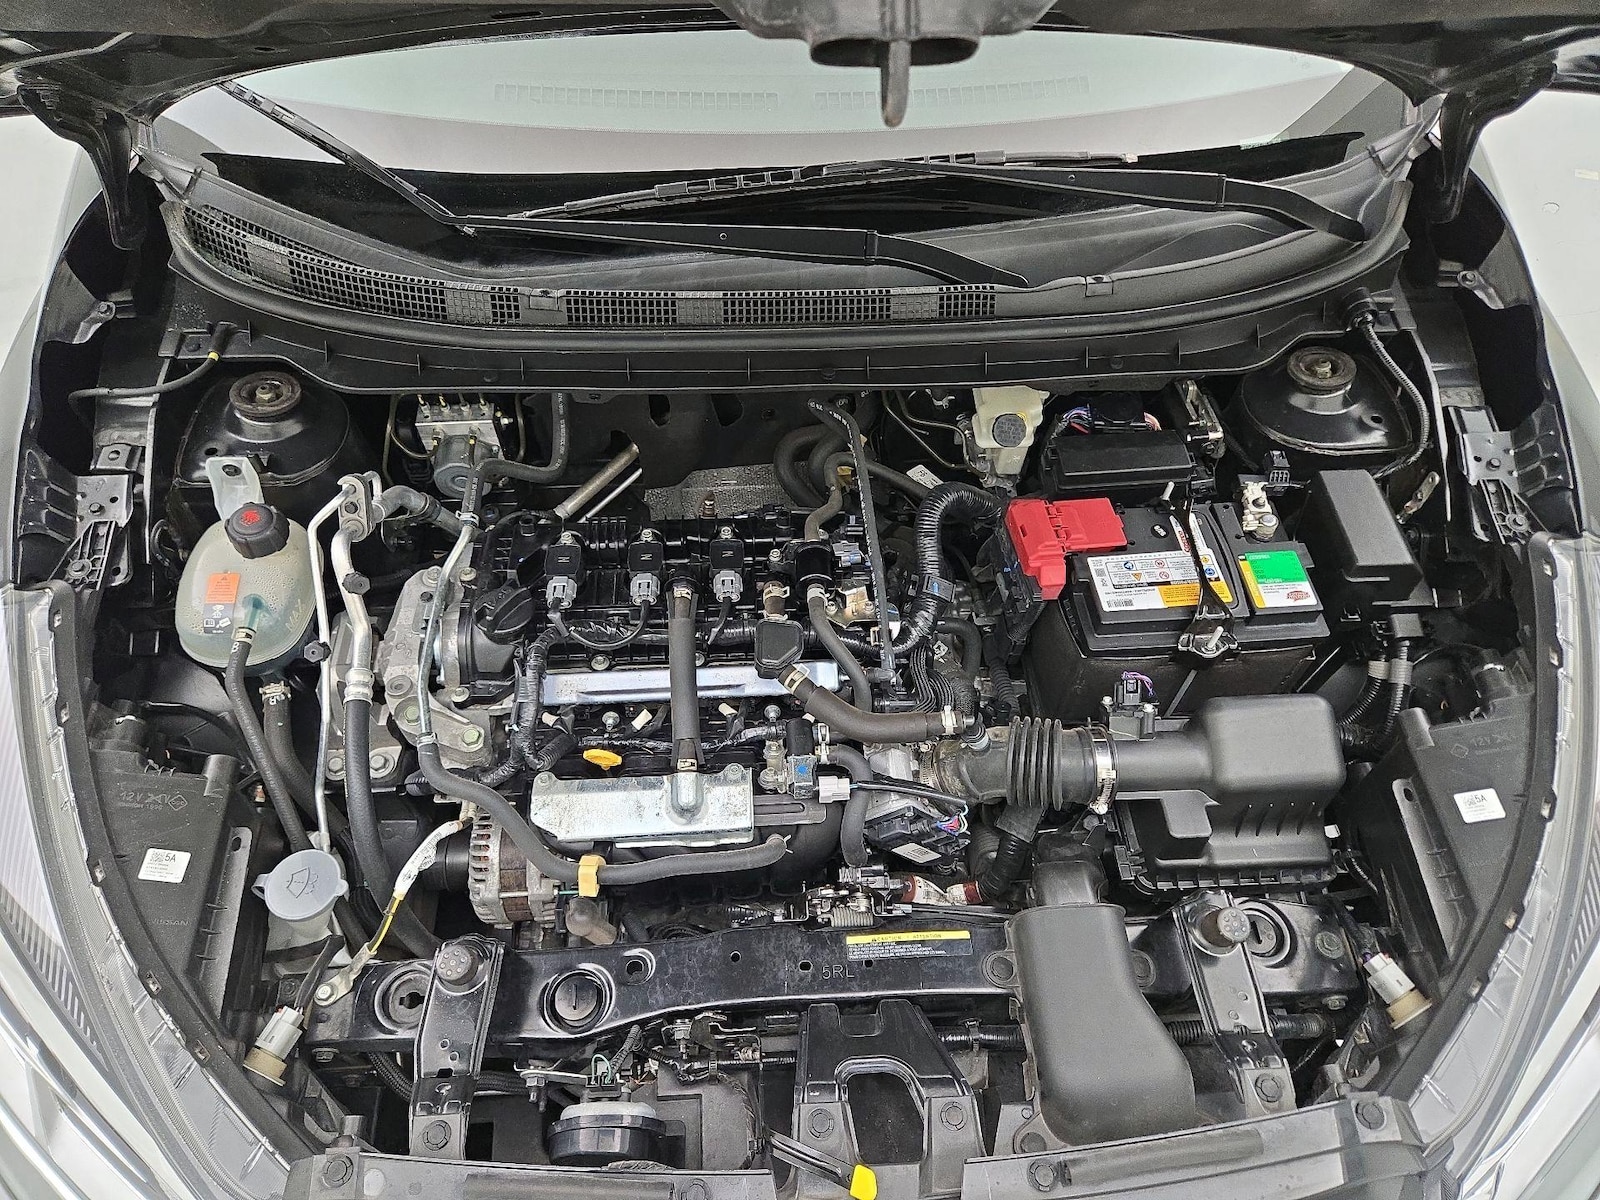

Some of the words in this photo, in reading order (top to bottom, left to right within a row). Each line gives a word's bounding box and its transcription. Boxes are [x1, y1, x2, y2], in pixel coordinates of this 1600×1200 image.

[285, 599, 306, 632] MAX
[1474, 794, 1487, 803] 5A
[164, 852, 176, 863] 5A
[821, 964, 855, 980] 5RL
